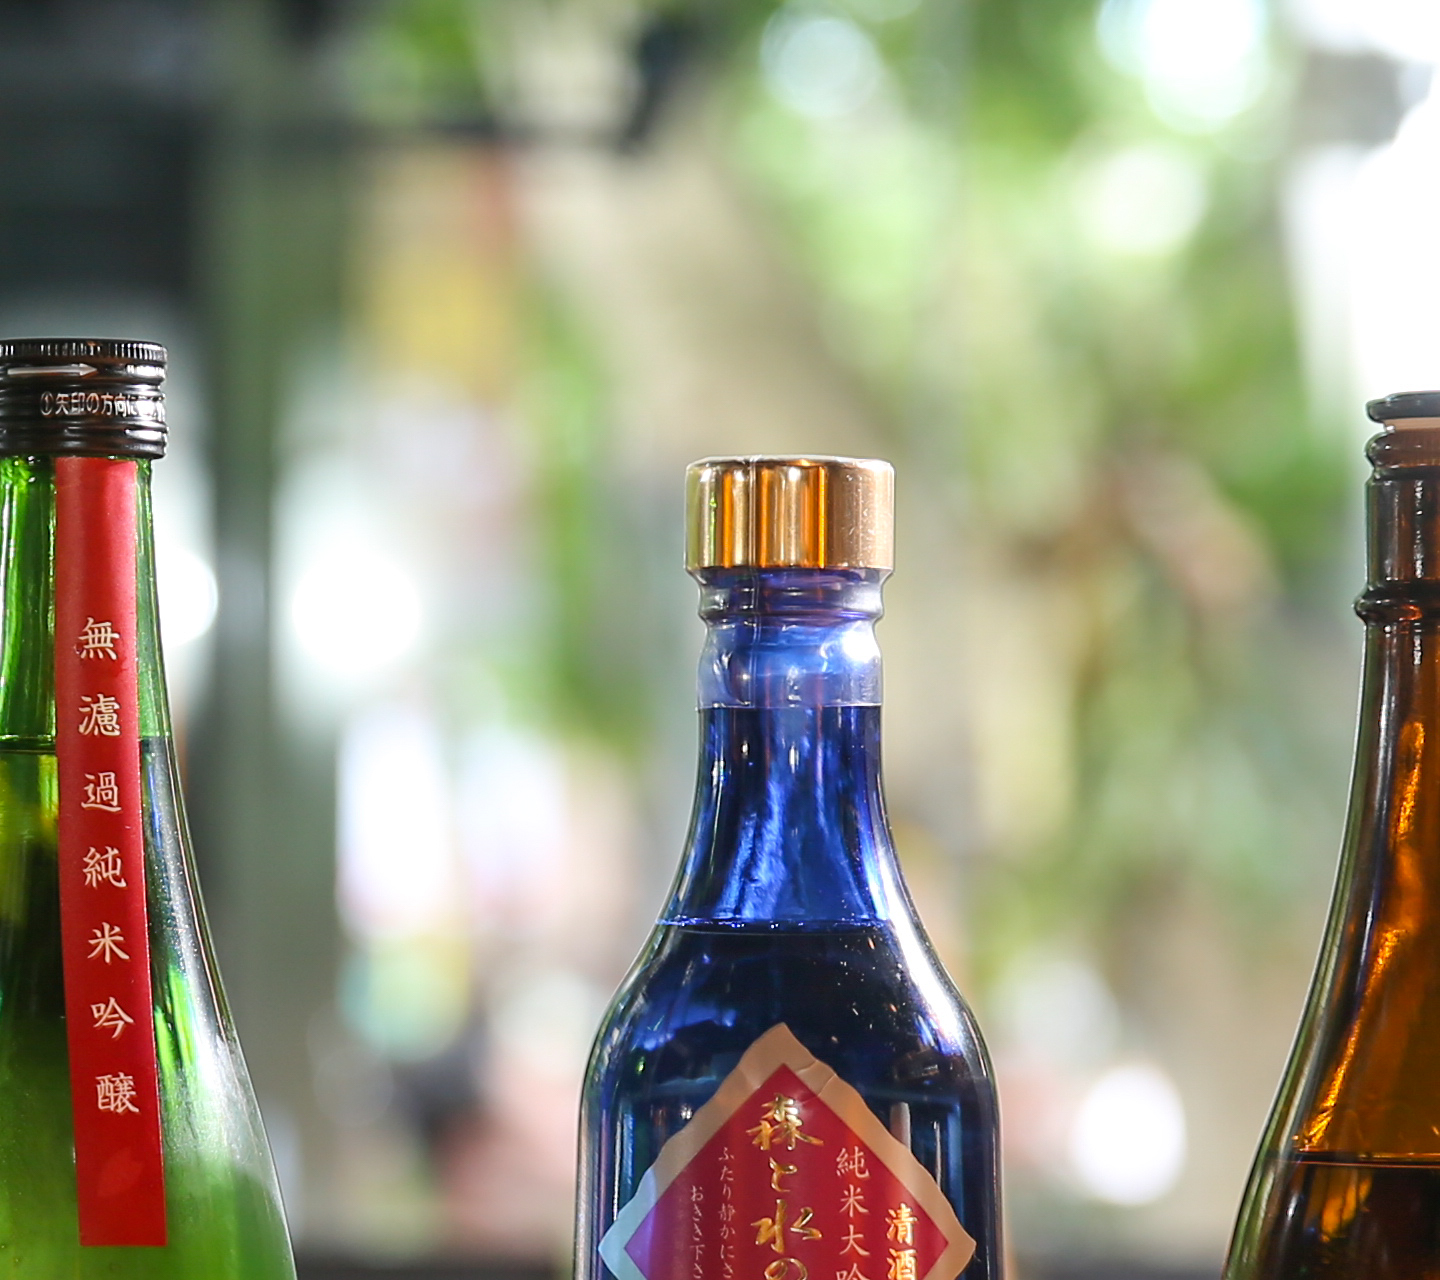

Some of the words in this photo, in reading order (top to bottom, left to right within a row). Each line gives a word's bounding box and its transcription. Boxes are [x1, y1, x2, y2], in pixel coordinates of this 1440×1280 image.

[76, 615, 141, 1118] 無濾過純米吟醸
